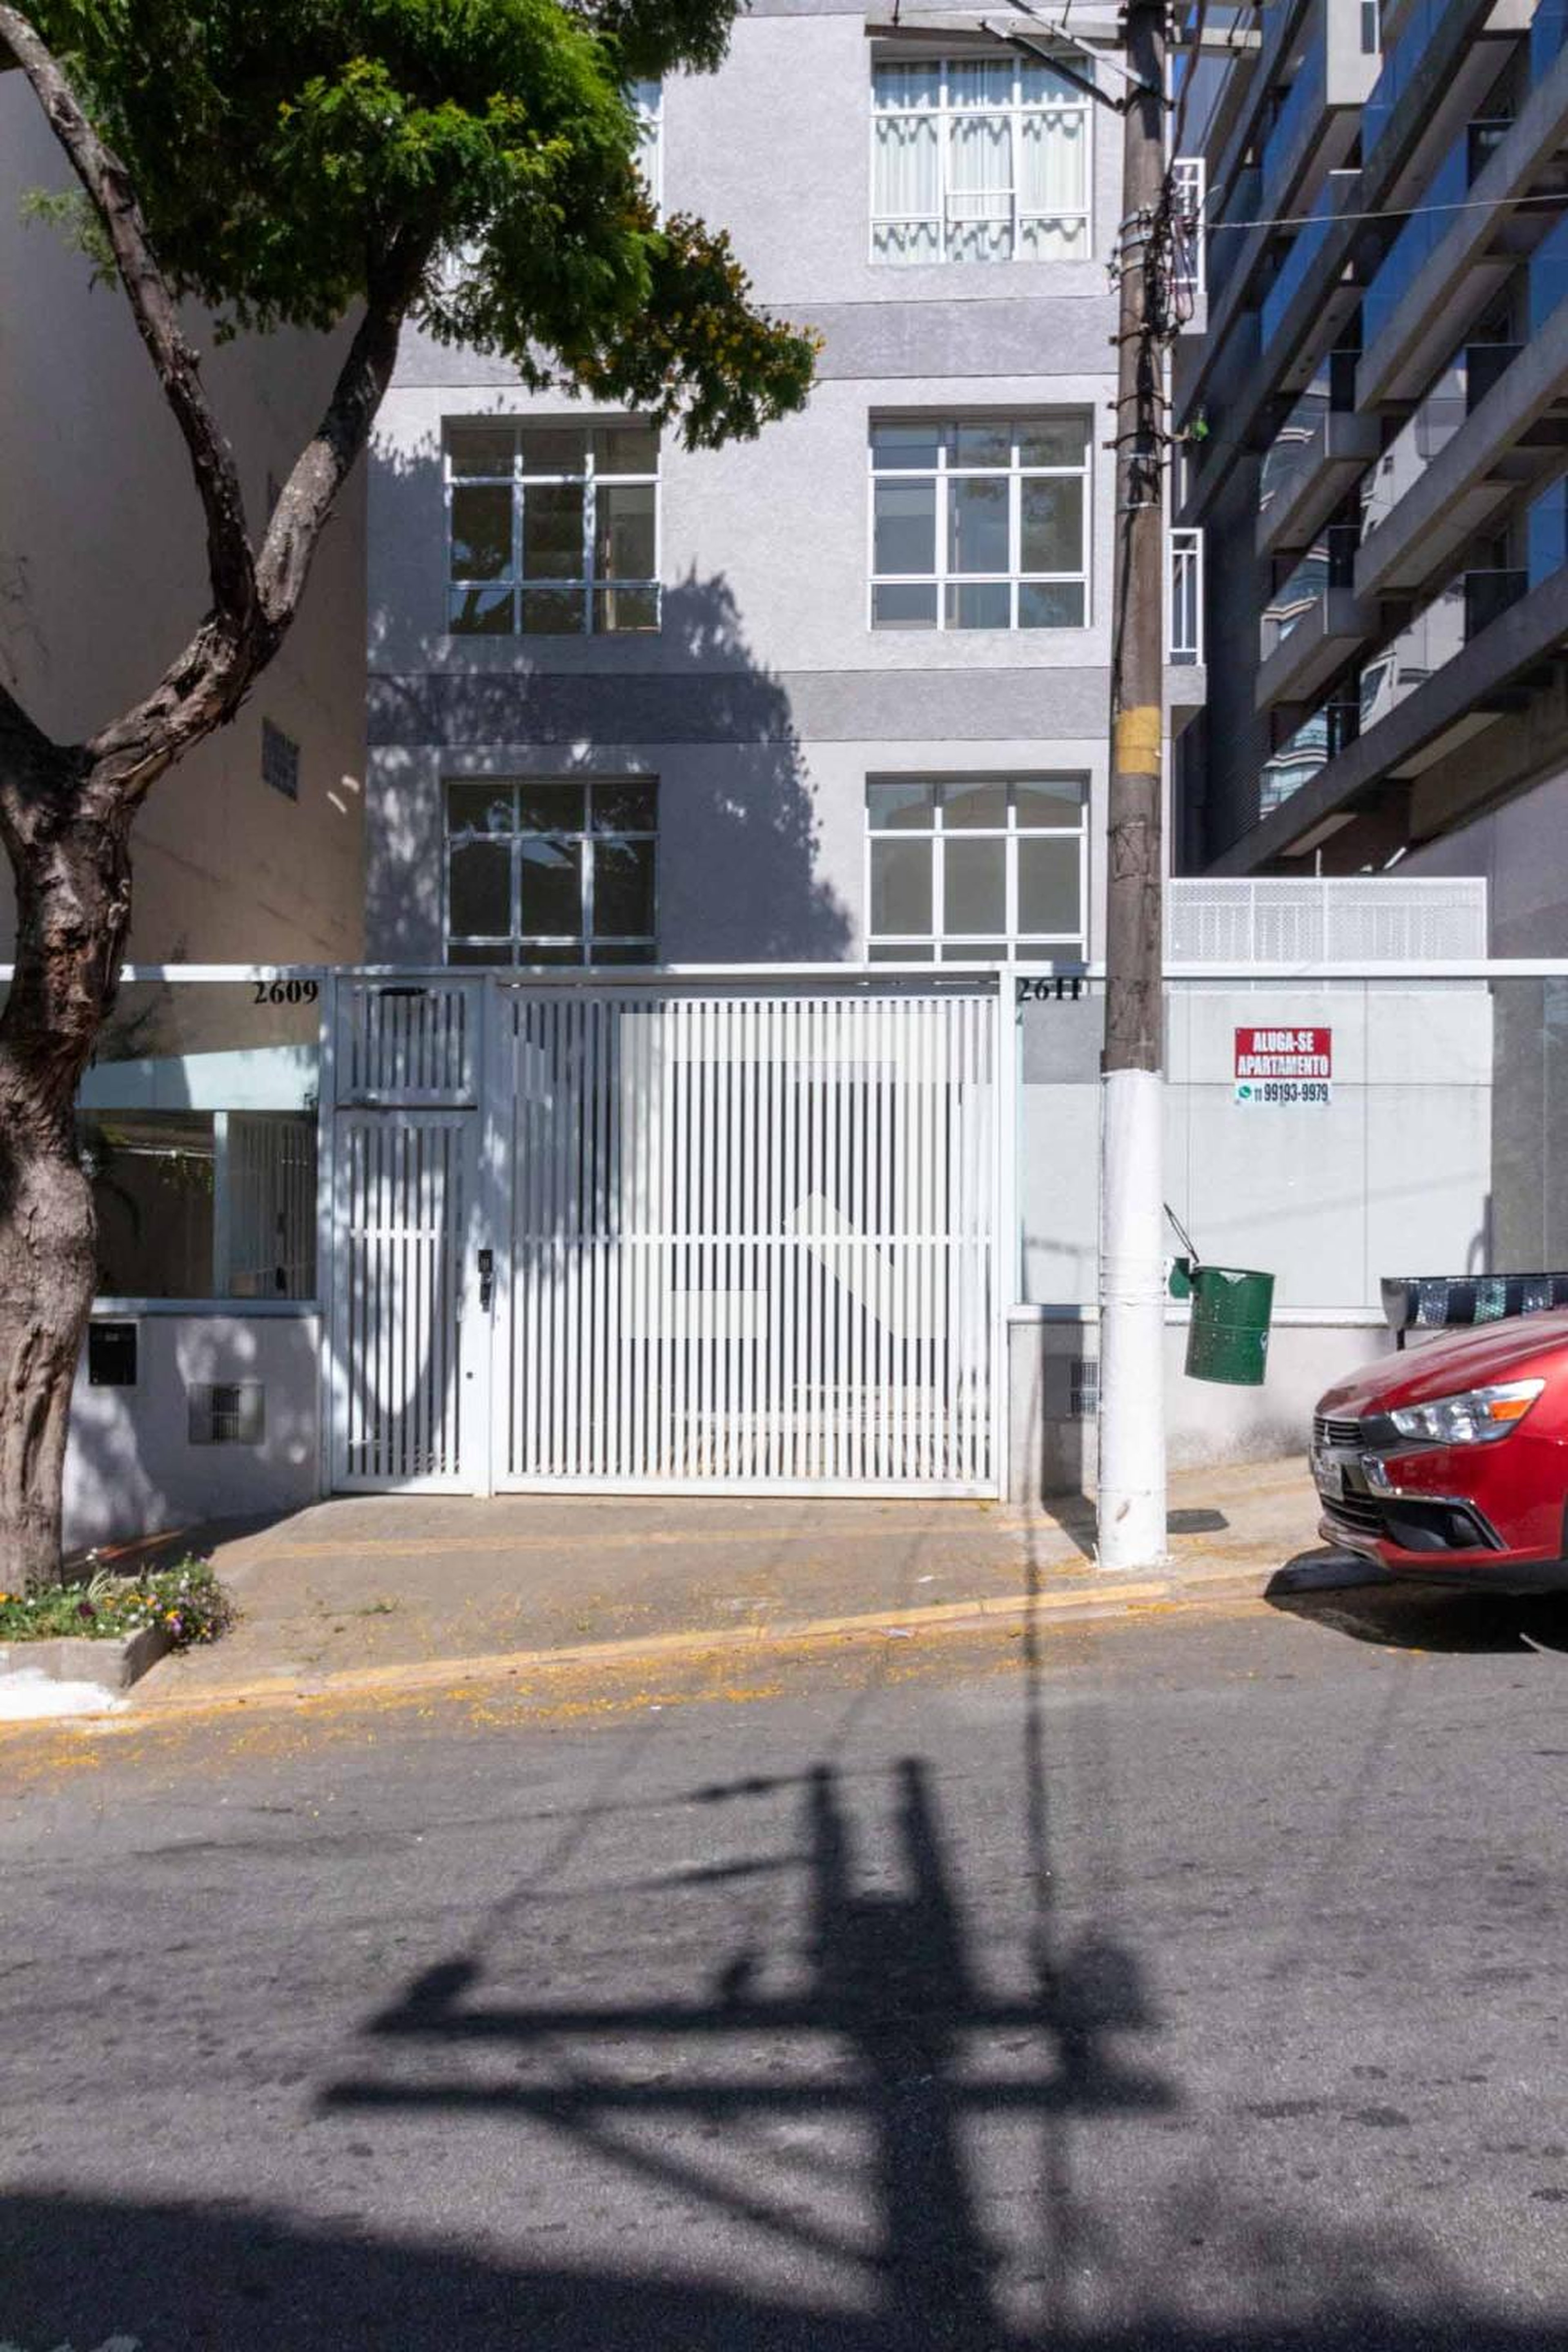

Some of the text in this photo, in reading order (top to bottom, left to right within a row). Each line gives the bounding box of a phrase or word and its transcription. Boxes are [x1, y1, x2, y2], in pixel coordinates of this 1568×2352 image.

[253, 980, 319, 1004] 2609
[1017, 977, 1079, 1000] 2611
[1253, 1031, 1314, 1052] ALUGA-SE
[1238, 1055, 1328, 1076] APARTAMENTO
[1264, 1084, 1328, 1101] 99193-9979
